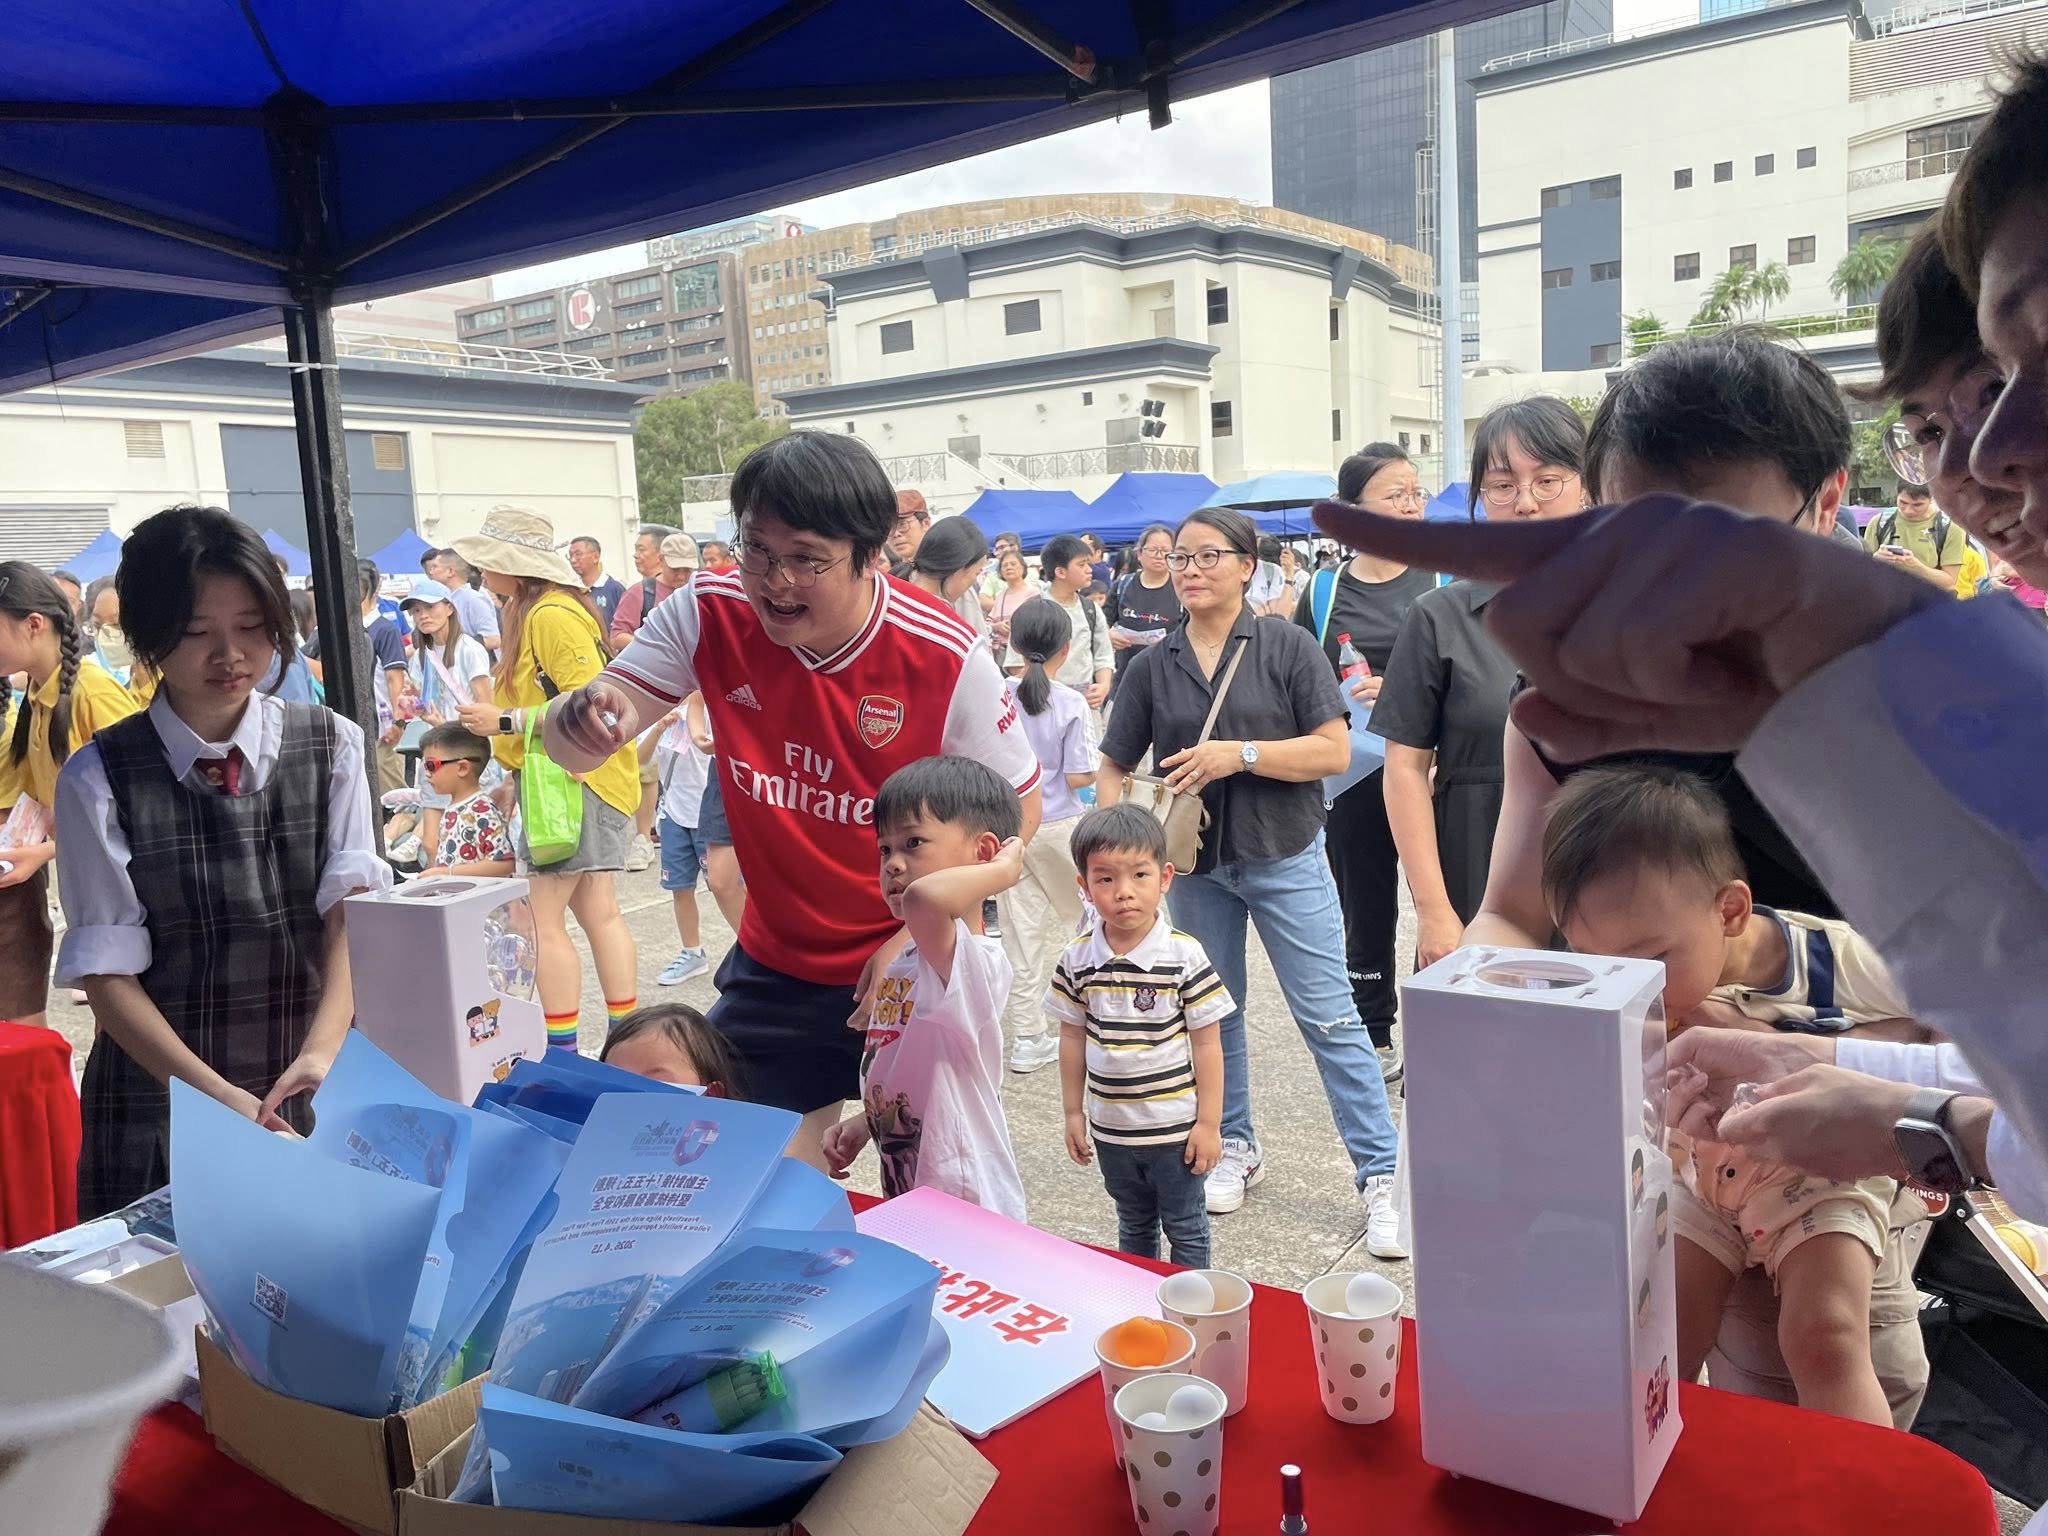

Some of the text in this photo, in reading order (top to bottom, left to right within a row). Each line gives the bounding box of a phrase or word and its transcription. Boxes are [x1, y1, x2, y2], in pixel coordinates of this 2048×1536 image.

[725, 693, 763, 711] adidas
[865, 704, 897, 717] Arsenal
[784, 741, 834, 784] Fly
[728, 755, 874, 825] Emirate
[1911, 1187, 1943, 1201] INGS
